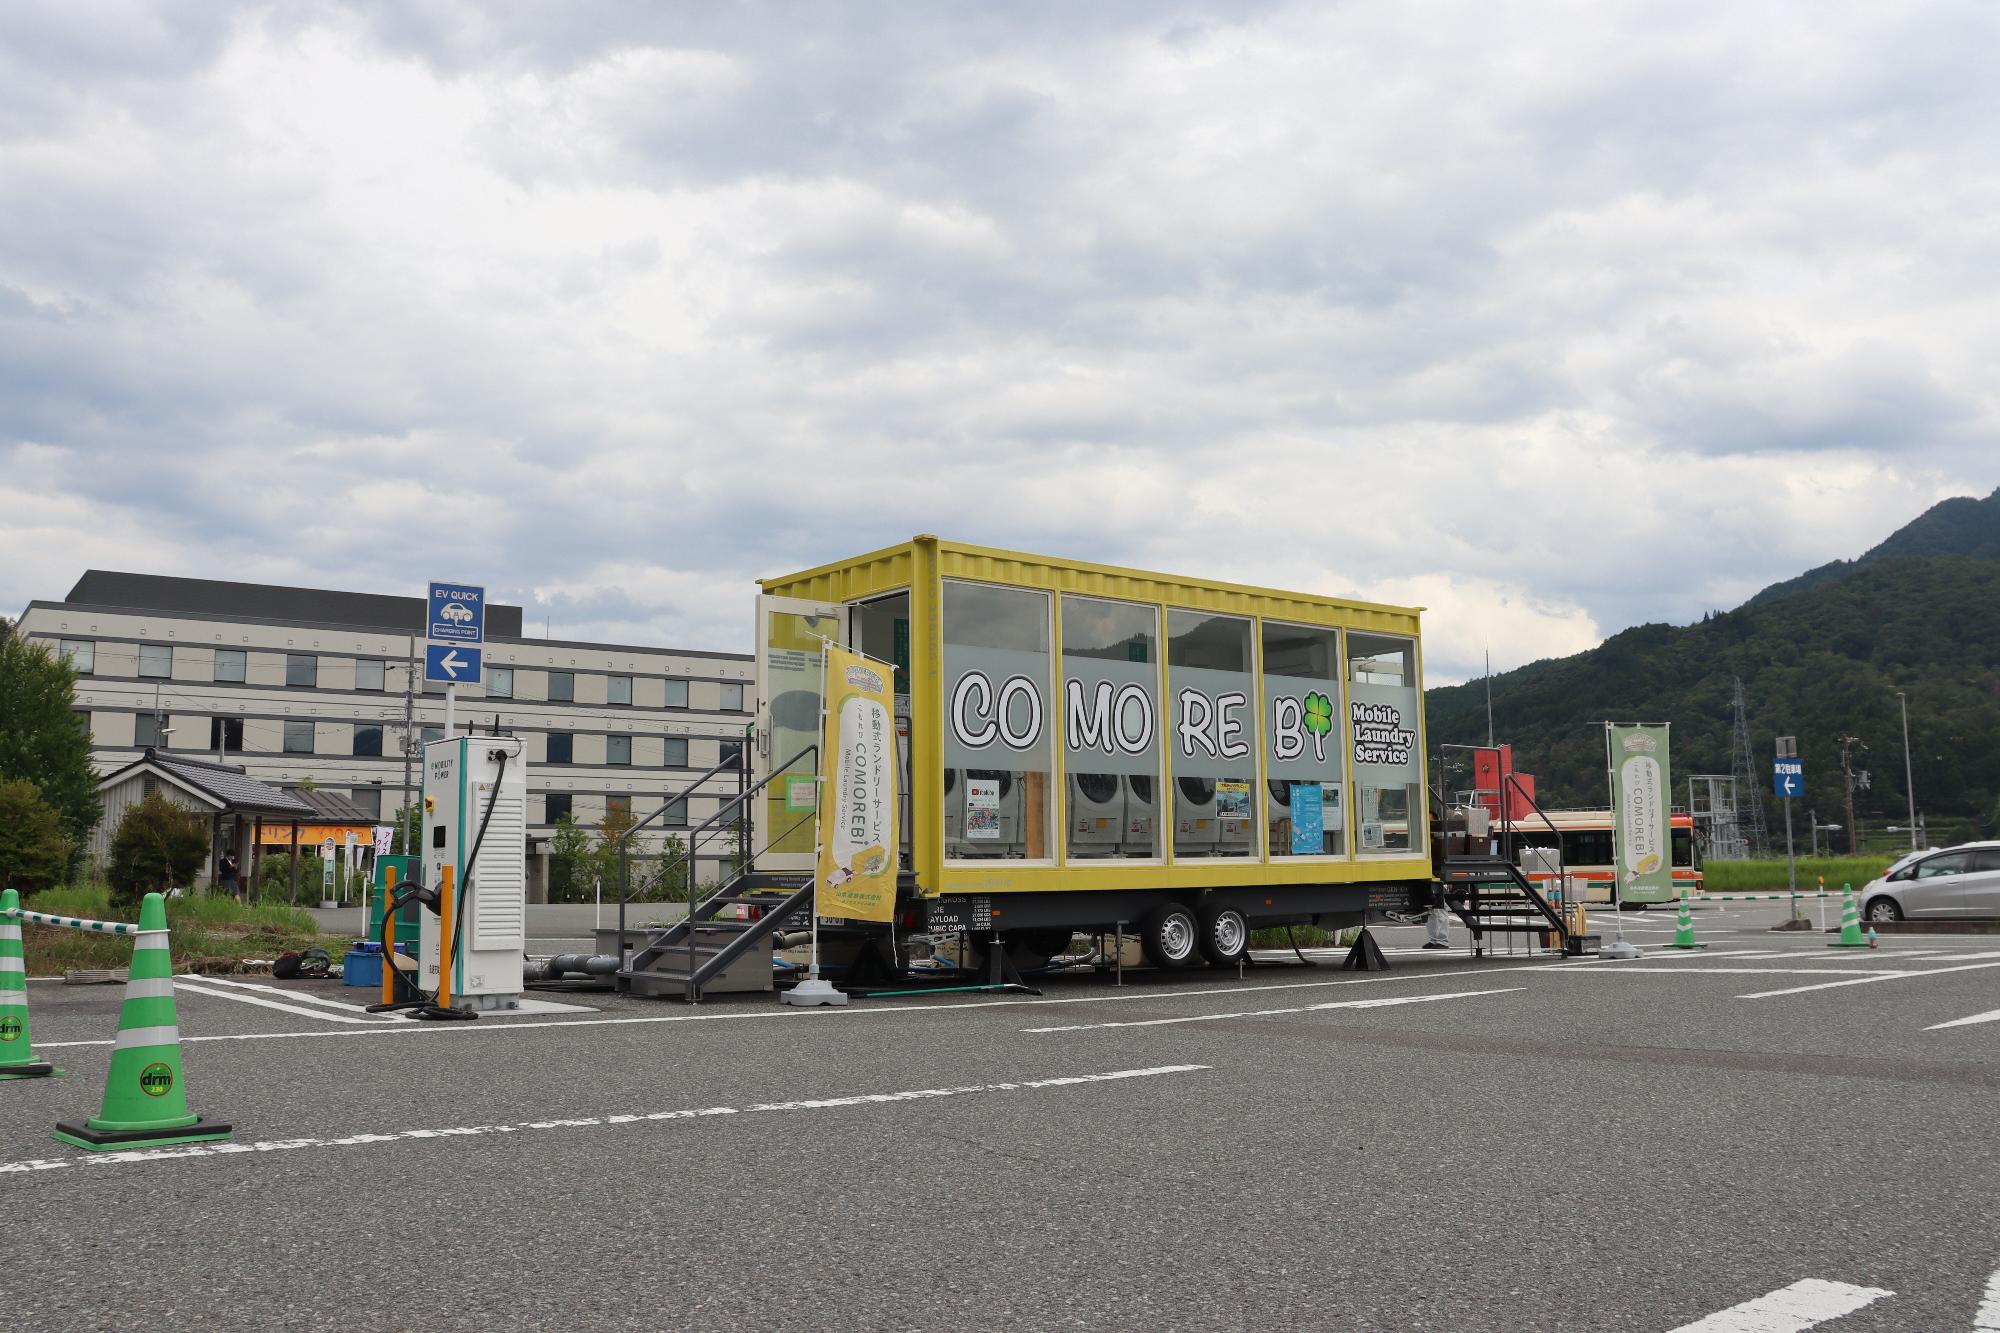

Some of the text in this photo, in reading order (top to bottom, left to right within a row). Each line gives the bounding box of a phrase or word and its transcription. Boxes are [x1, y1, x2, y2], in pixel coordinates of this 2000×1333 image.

[435, 590, 479, 602] EV QUICK
[434, 627, 460, 635] CHARGING
[1352, 703, 1400, 724] Mobile
[1354, 724, 1415, 749] Laundry
[1354, 744, 1408, 763] Service
[872, 707, 882, 843] 移動式ランドリーサービス
[1774, 763, 1802, 775] 第2駐車場
[928, 915, 959, 923] AYLOAD
[142, 1072, 171, 1086] drm
